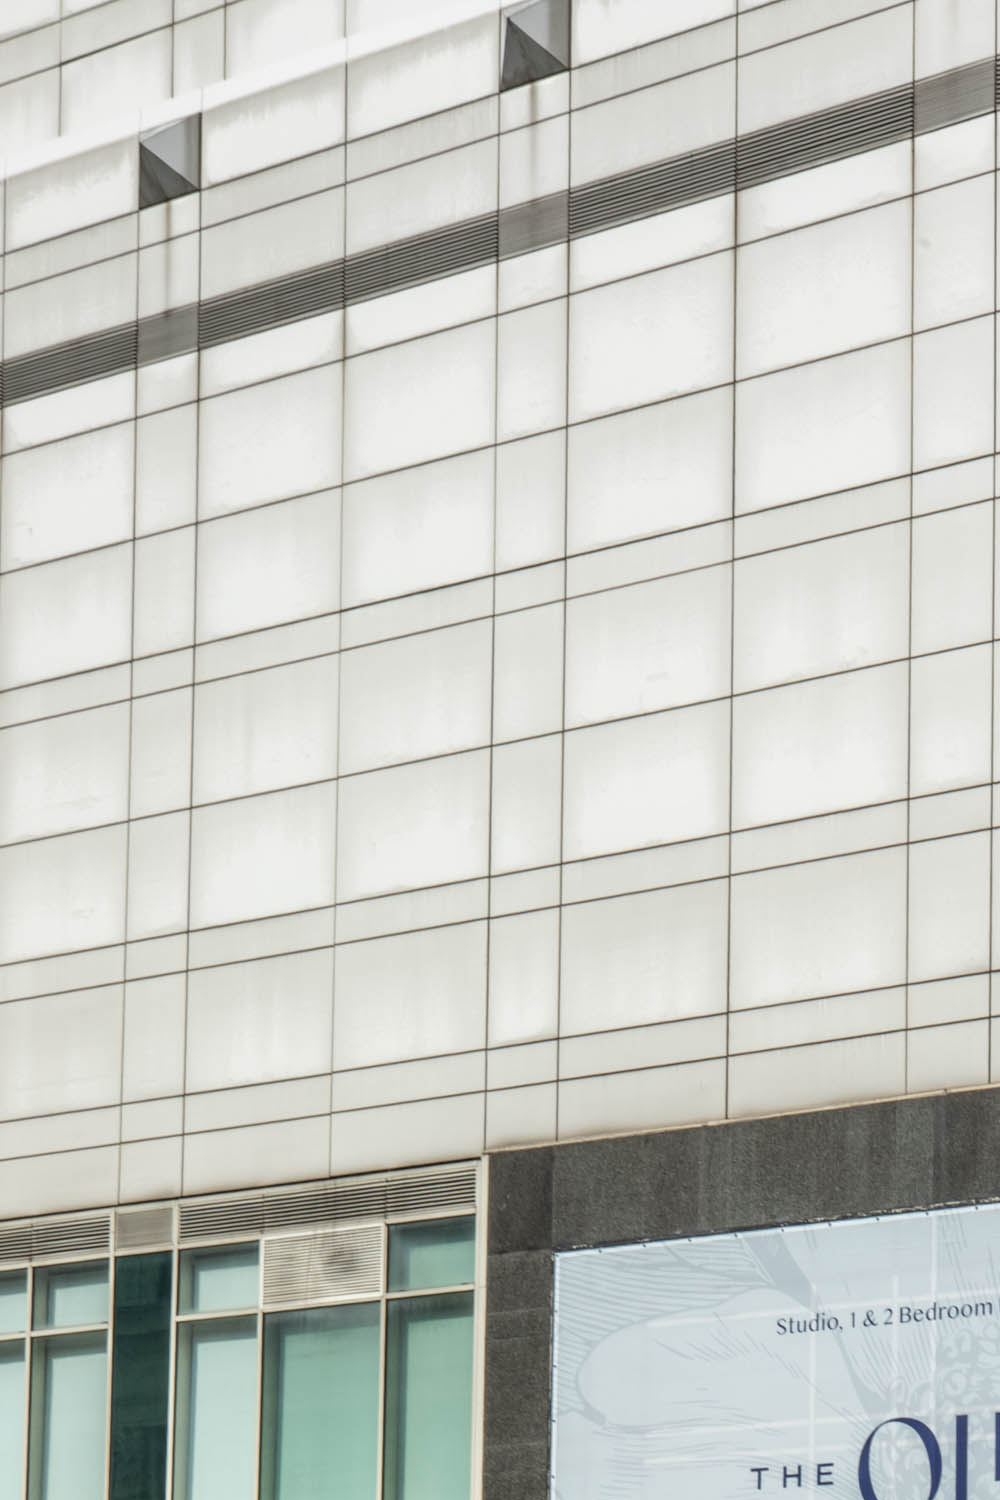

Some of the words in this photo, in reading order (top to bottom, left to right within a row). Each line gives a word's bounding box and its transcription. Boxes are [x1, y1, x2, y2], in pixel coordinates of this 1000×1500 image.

[776, 1312, 844, 1336] Studio,
[850, 1311, 856, 1329] 1
[862, 1311, 879, 1328] &
[883, 1307, 894, 1326] 2
[899, 1299, 993, 1324] Bedroom
[750, 1463, 835, 1491] THE
